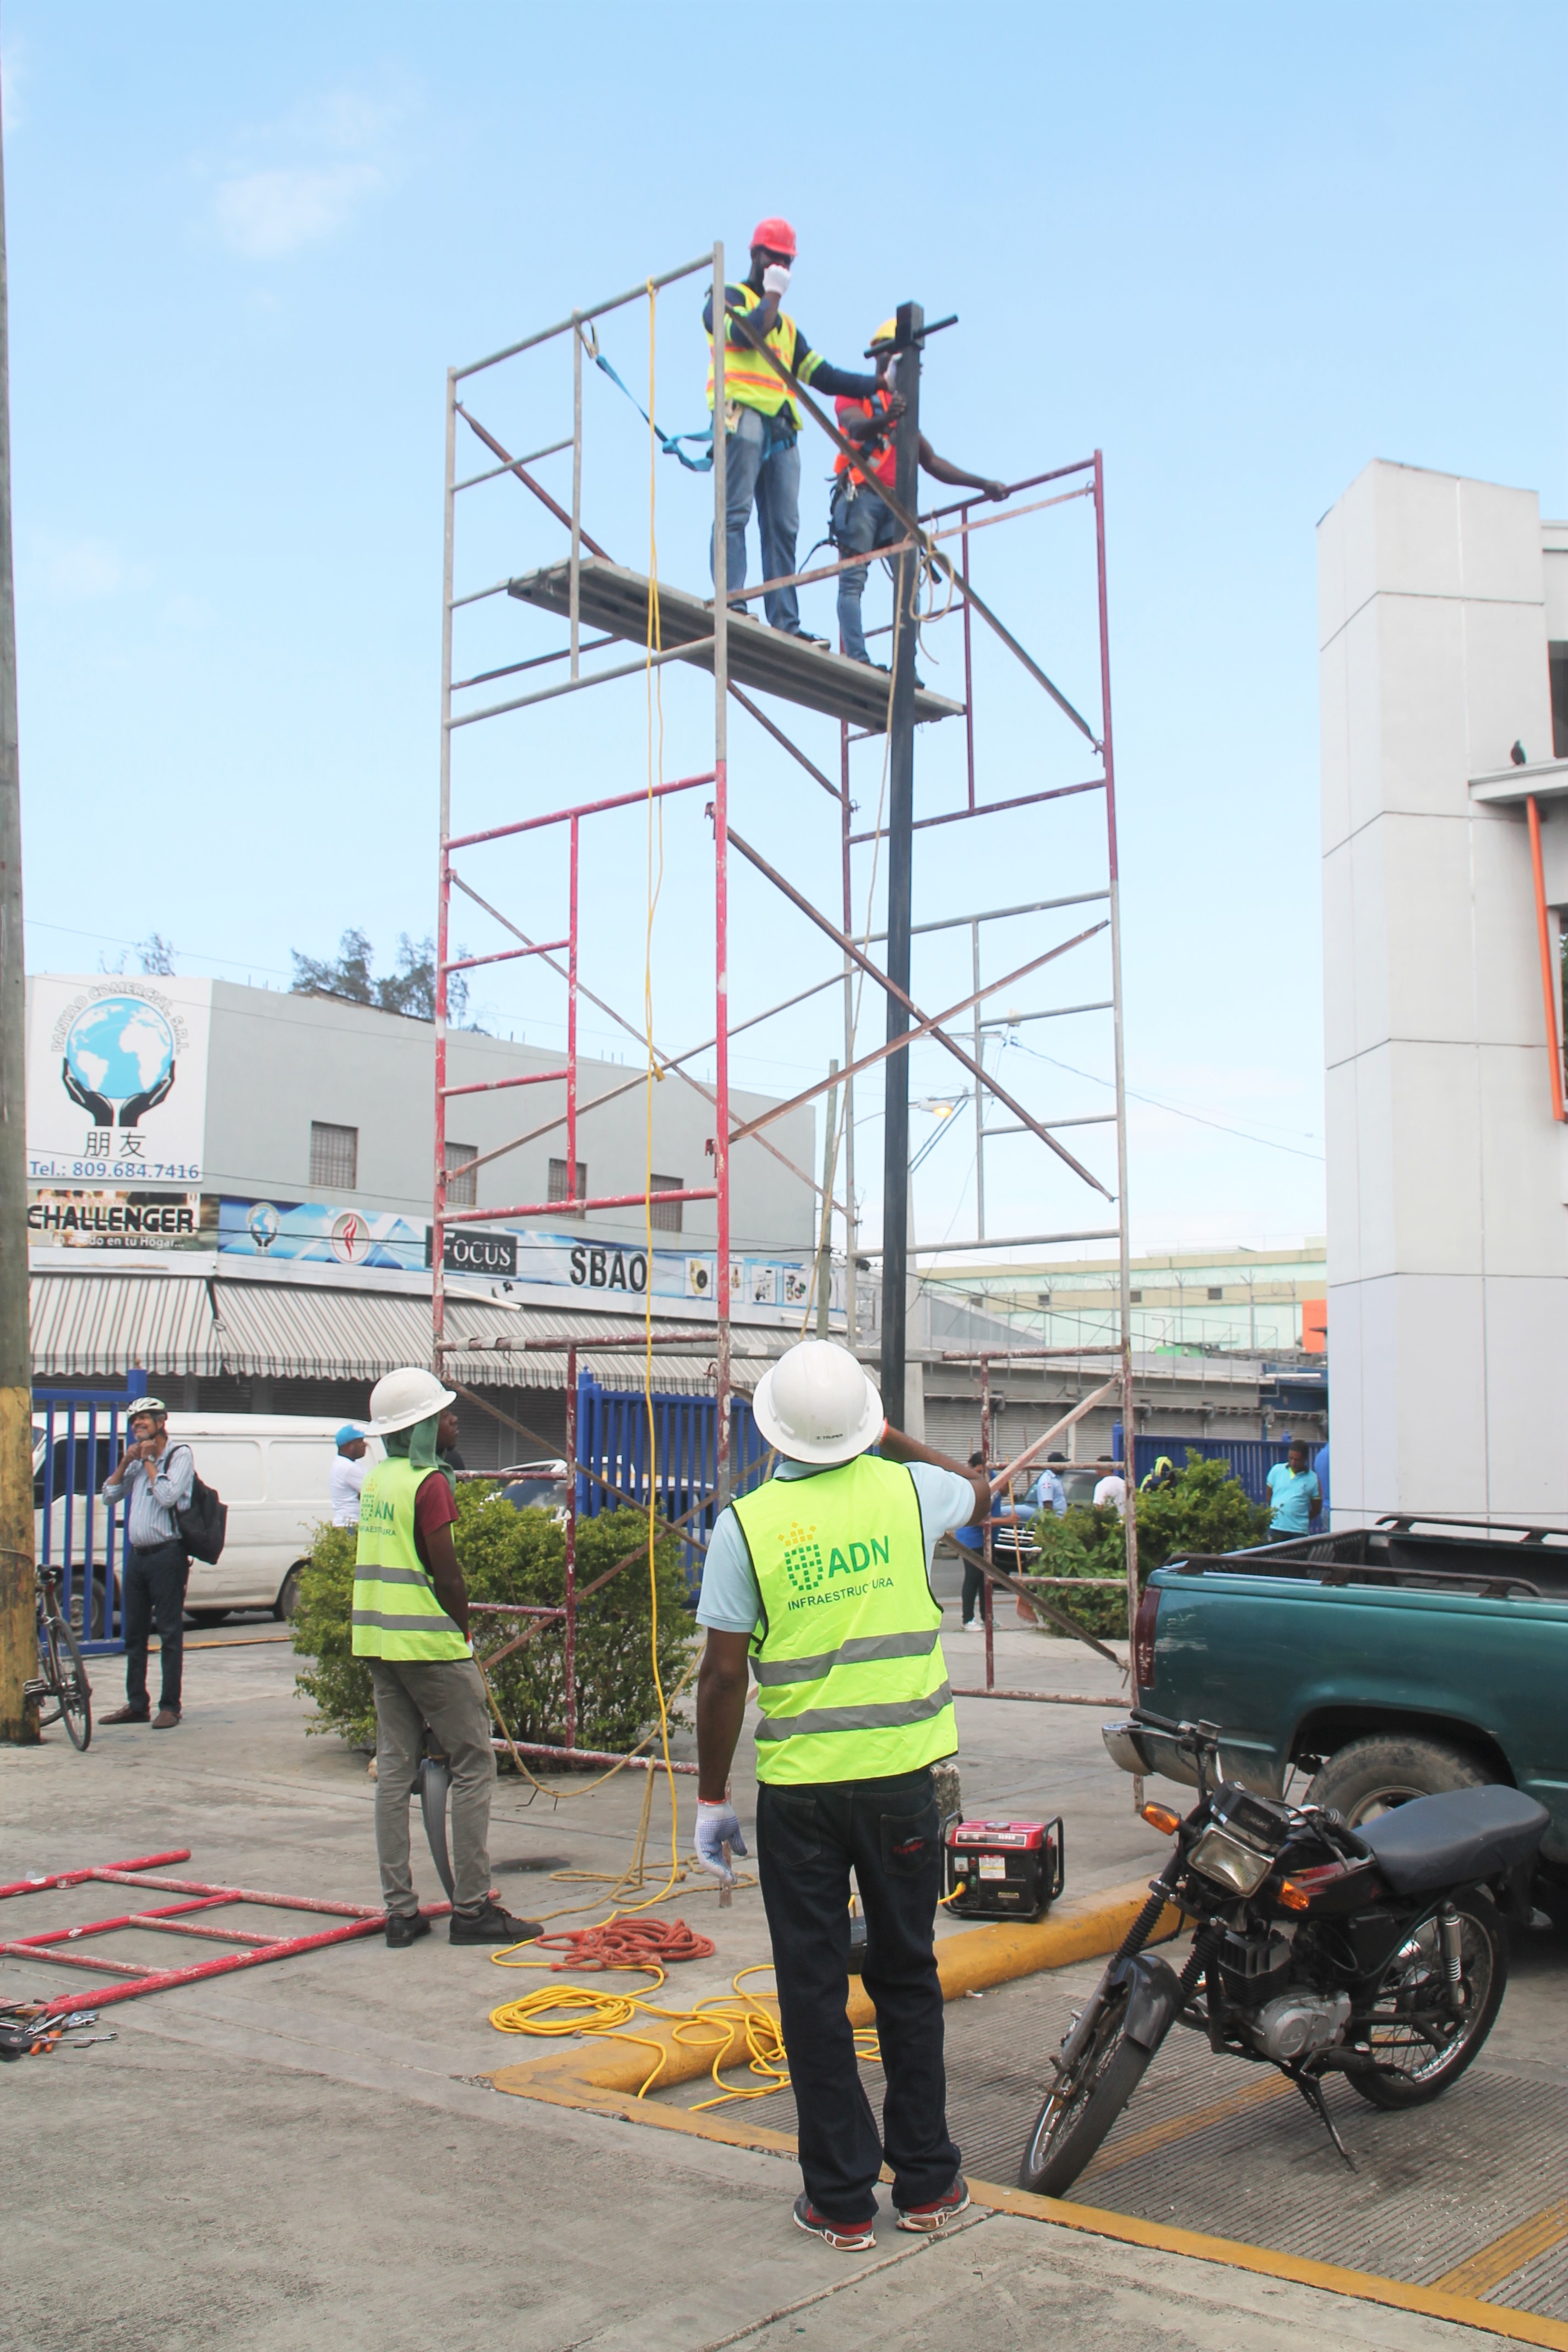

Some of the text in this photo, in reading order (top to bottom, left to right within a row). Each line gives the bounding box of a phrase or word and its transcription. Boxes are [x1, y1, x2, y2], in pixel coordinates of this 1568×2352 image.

[72, 1162, 199, 1179] 809.684.7416
[28, 1205, 193, 1233] CHALLENGER
[107, 1237, 121, 1246] en
[124, 1236, 137, 1246] tu
[570, 1244, 647, 1292] SBAO
[827, 1535, 890, 1578] ADN
[787, 1577, 894, 1611] INFRAESTRUCURA
